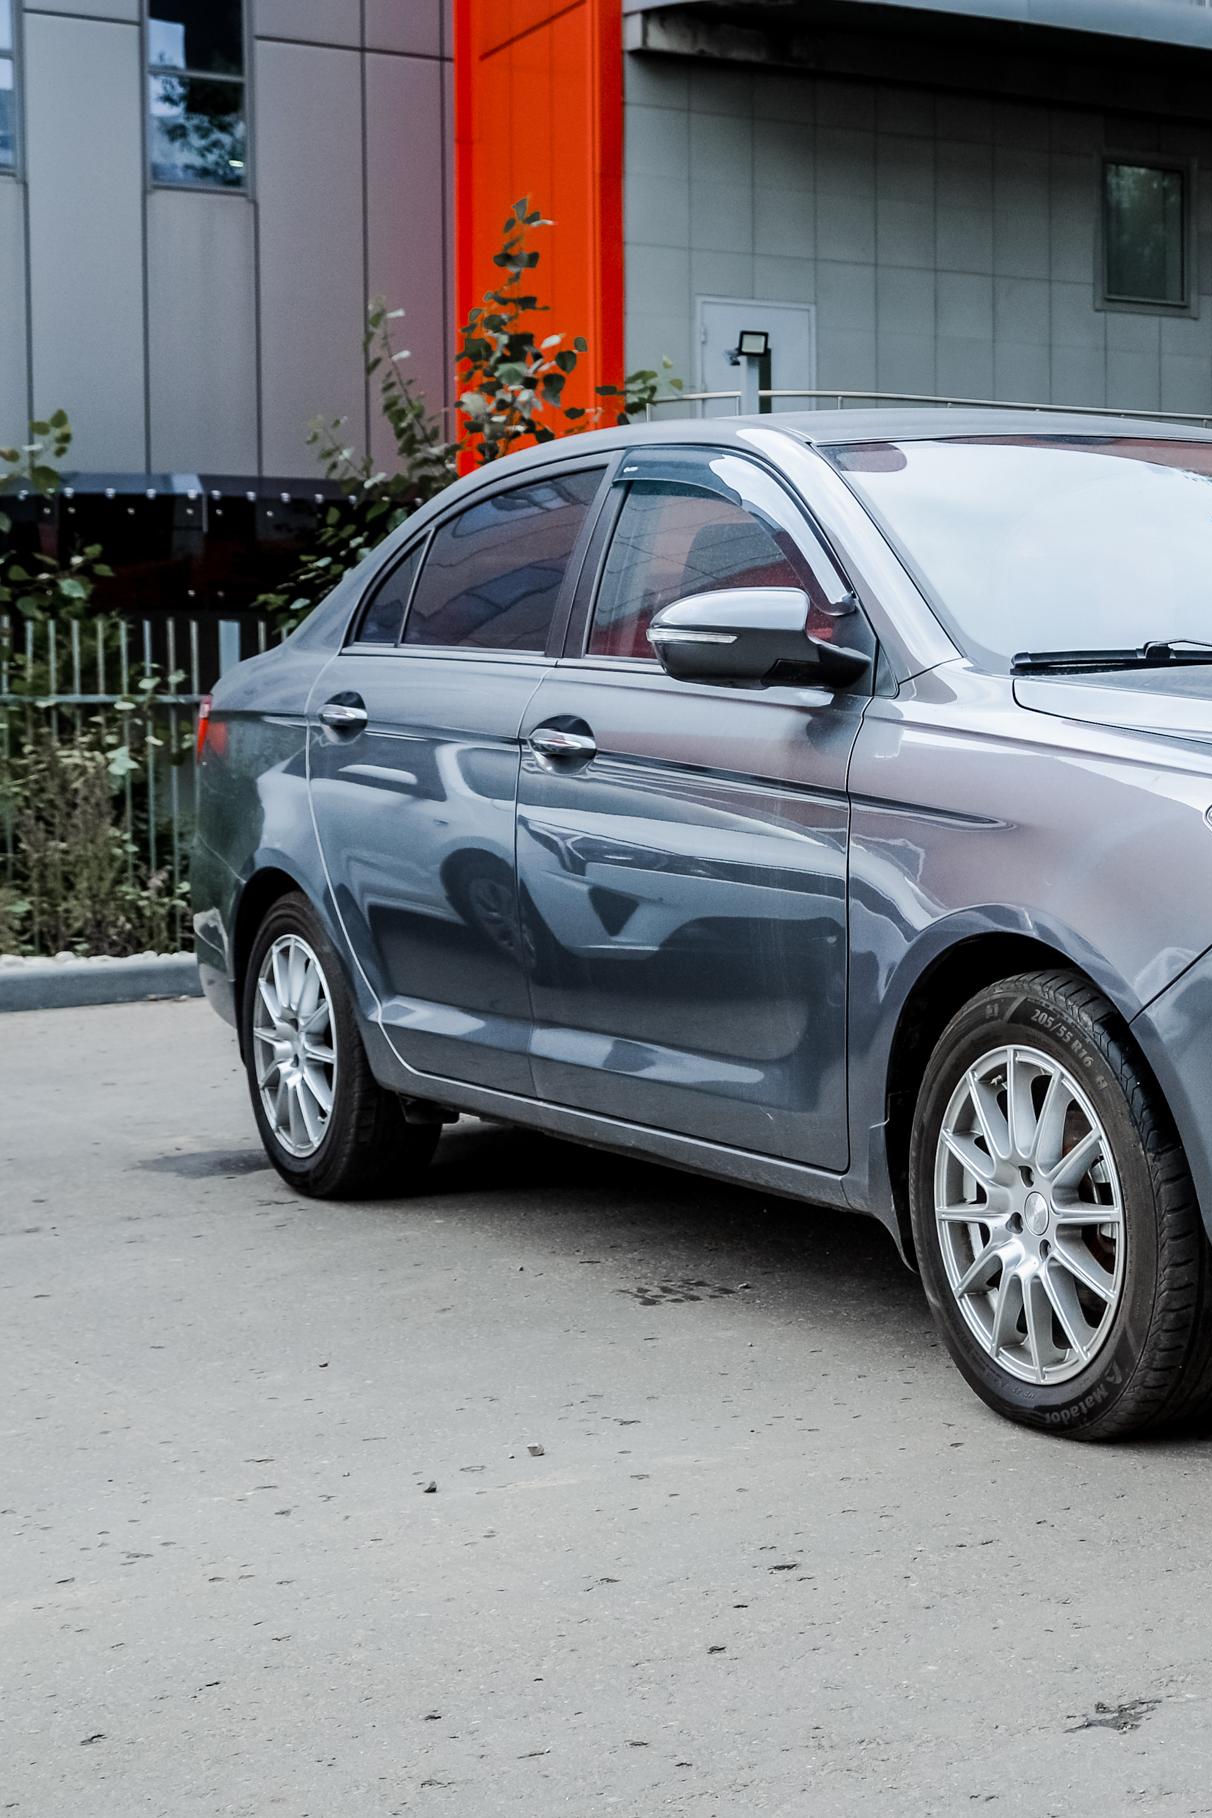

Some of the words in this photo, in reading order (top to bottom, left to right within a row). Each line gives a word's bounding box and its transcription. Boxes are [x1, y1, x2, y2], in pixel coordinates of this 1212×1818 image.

[1030, 1008, 1073, 1044] 205/55
[1071, 1040, 1094, 1067] R16
[1046, 1388, 1108, 1424] Matador
